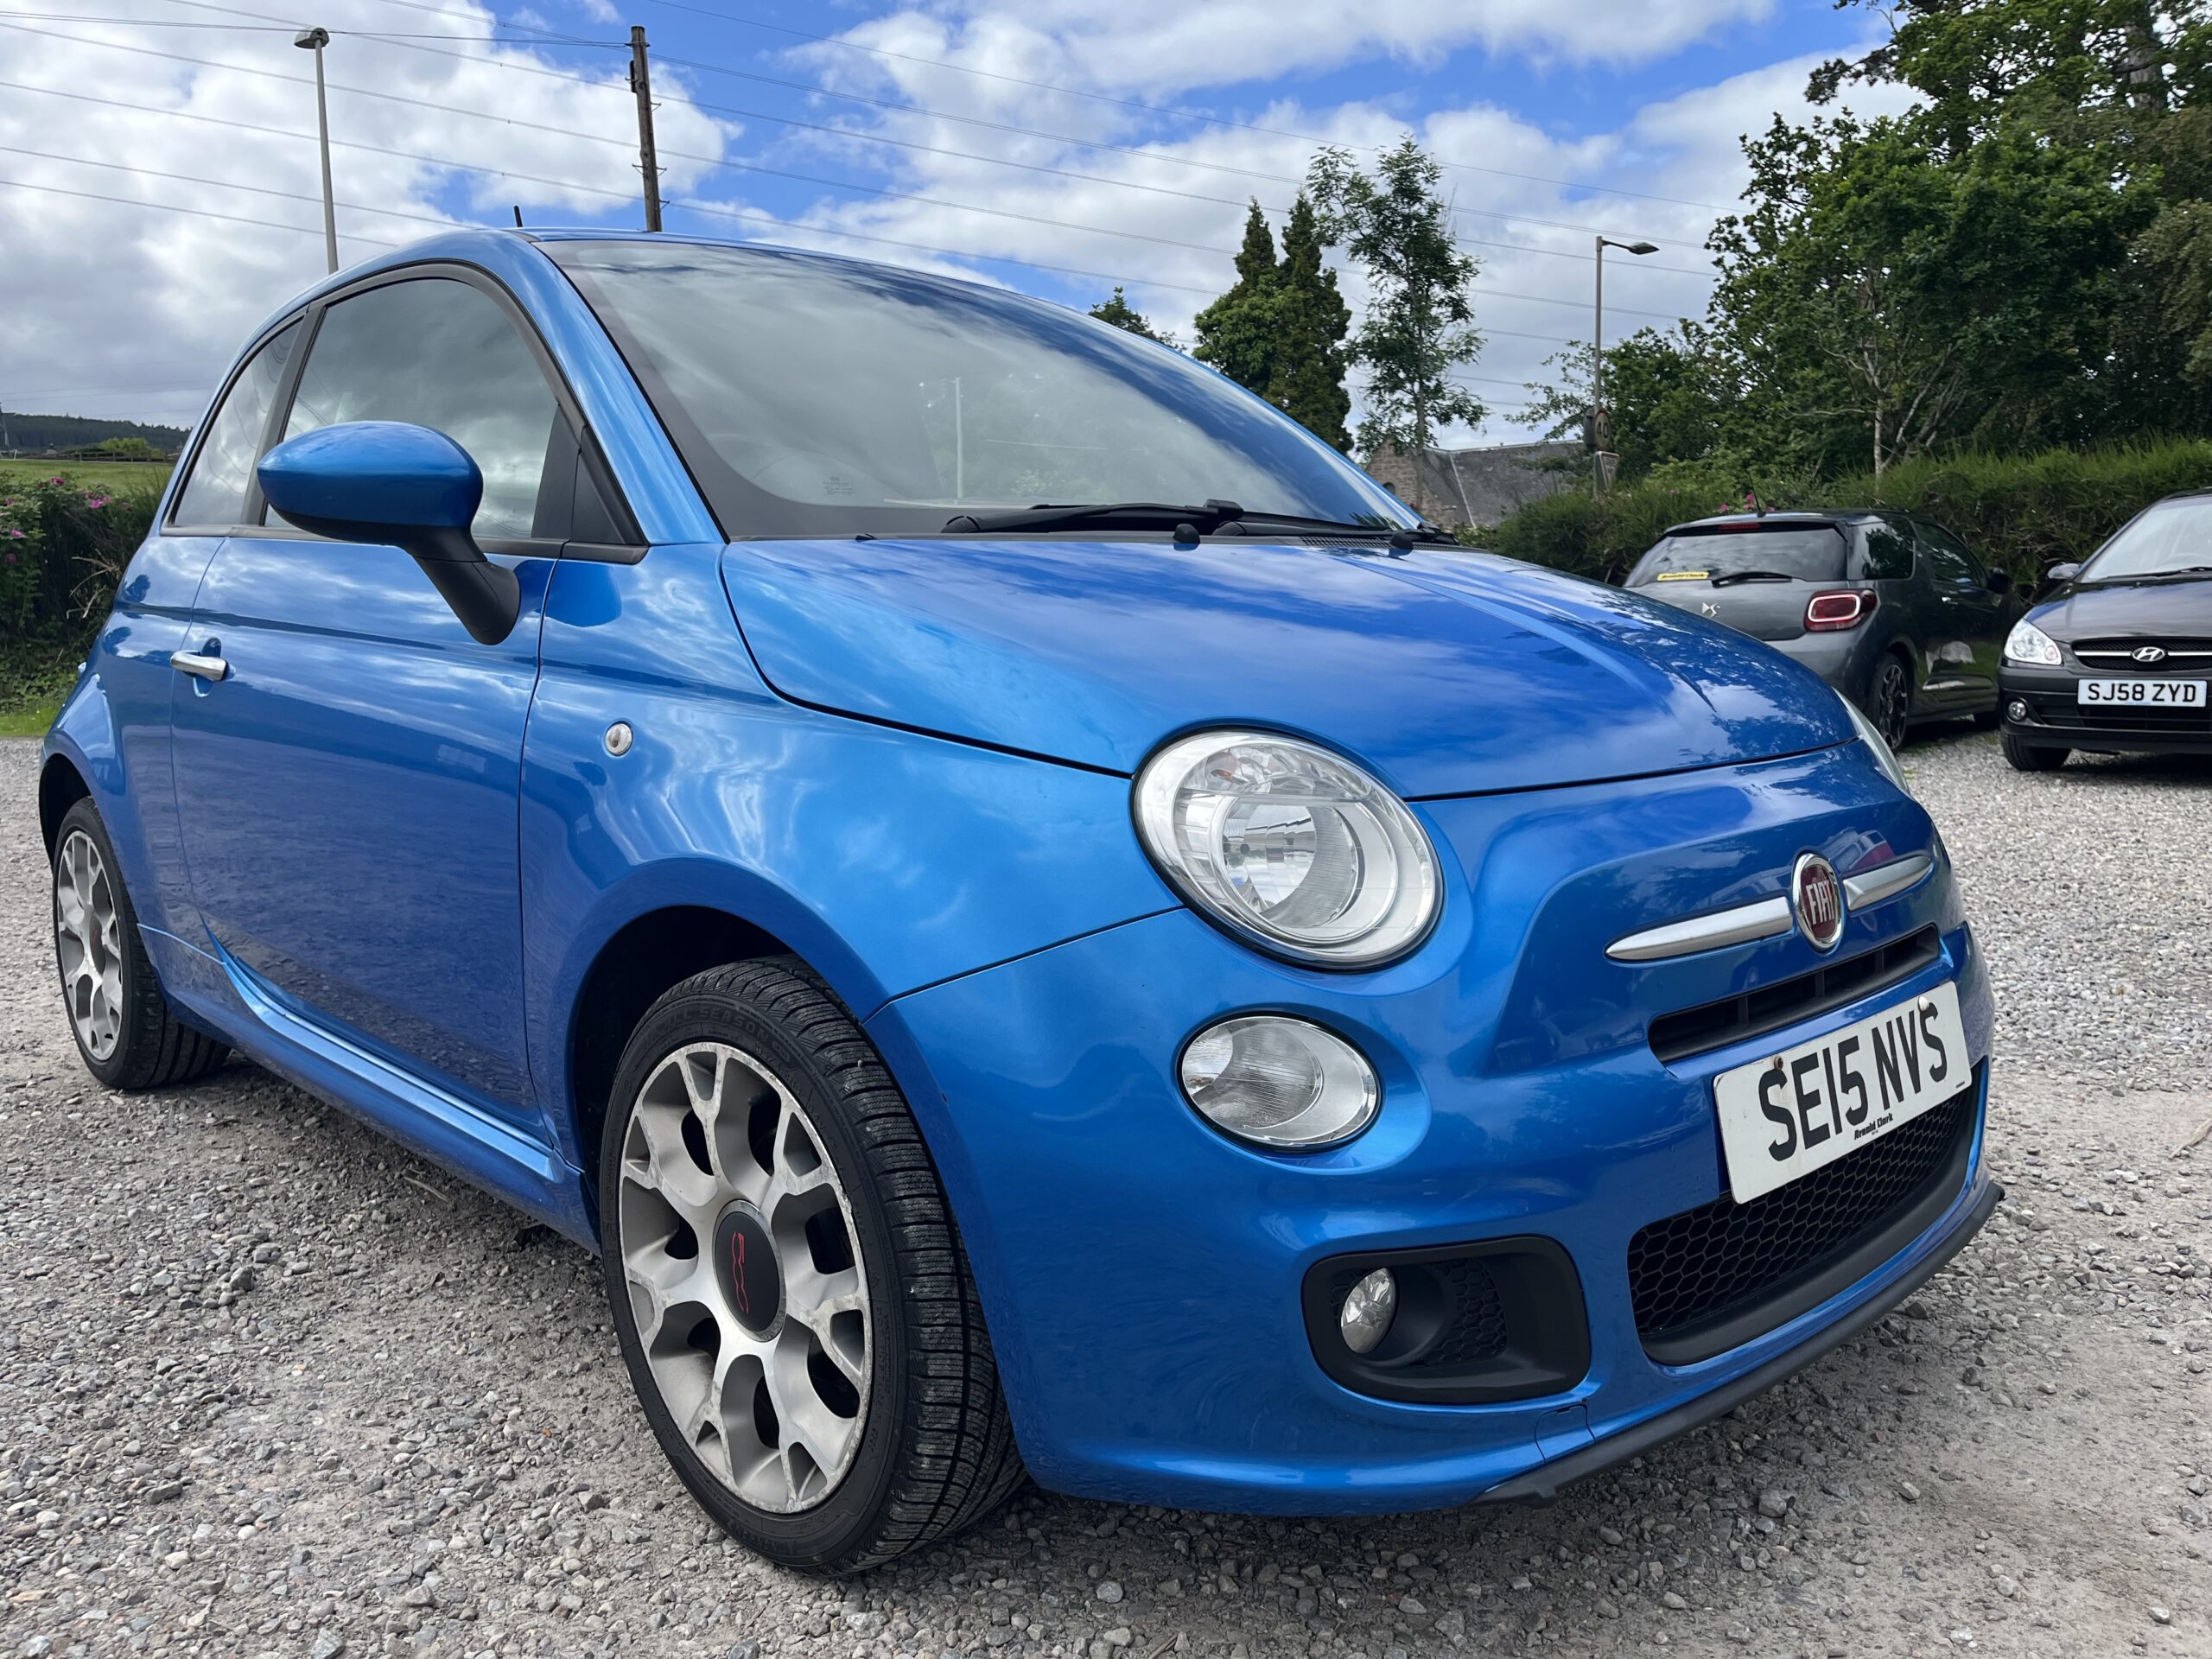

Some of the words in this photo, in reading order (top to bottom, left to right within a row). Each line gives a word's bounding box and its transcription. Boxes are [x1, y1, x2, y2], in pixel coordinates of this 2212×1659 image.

[2087, 683, 2145, 702] SJ58
[2152, 683, 2197, 702] ZYD
[1806, 880, 1835, 925] FIAT
[1758, 1035, 1869, 1161] SE15
[1872, 1001, 1948, 1111] NVS
